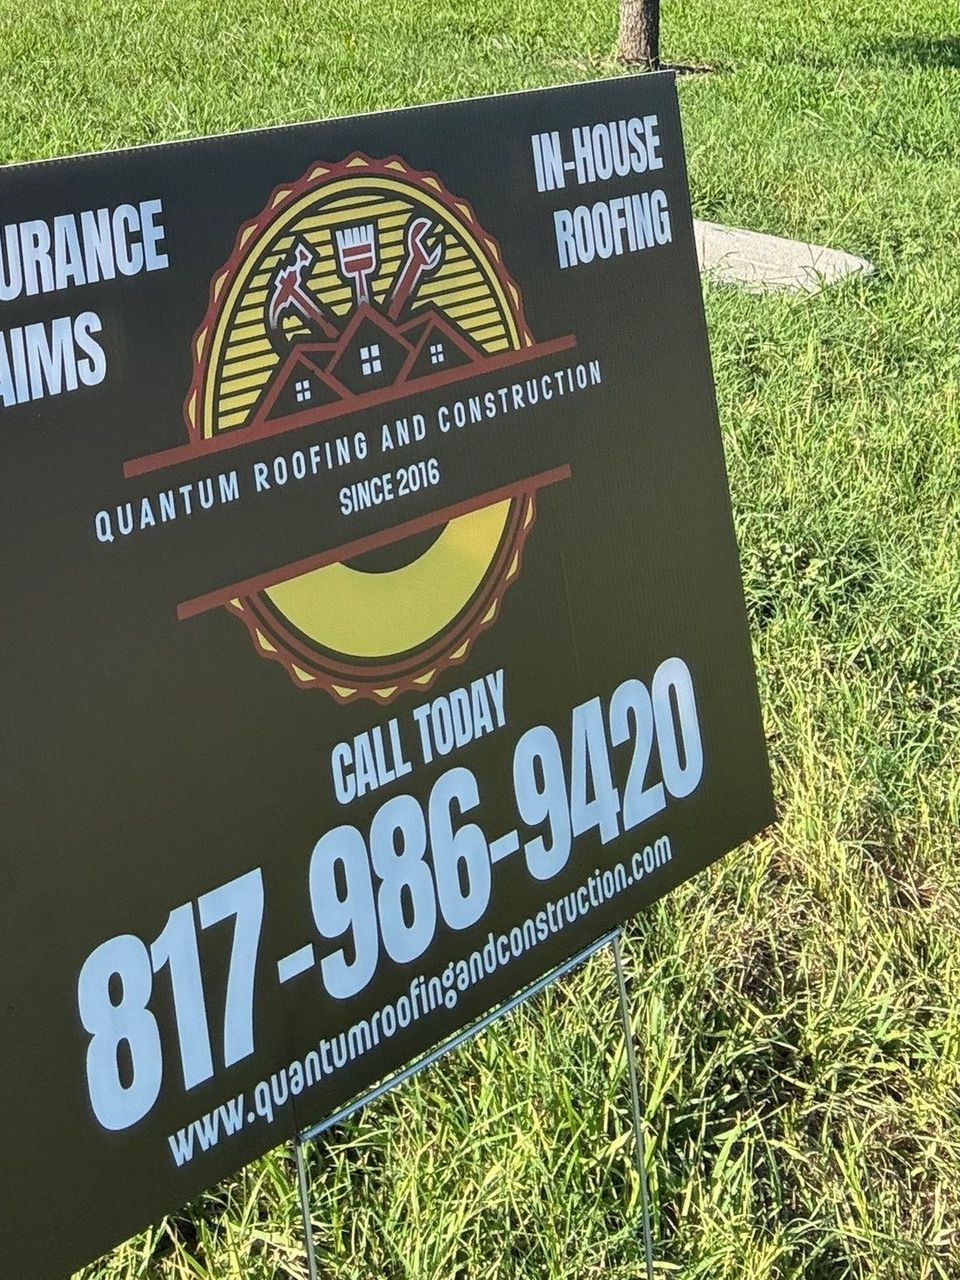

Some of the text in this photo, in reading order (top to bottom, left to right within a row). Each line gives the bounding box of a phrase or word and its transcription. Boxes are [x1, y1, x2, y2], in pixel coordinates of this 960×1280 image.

[531, 114, 664, 193] IN-HOUSE
[553, 189, 673, 269] ROOFING
[95, 360, 602, 543] QUANTUM ROOFING AND CONSTRUCTION
[339, 457, 440, 516] SINCE 2016
[331, 669, 508, 805] CALL TODAY
[77, 656, 705, 1132] 817-986-9420
[168, 834, 673, 1168] www.quantumroofingandconstruction.com
